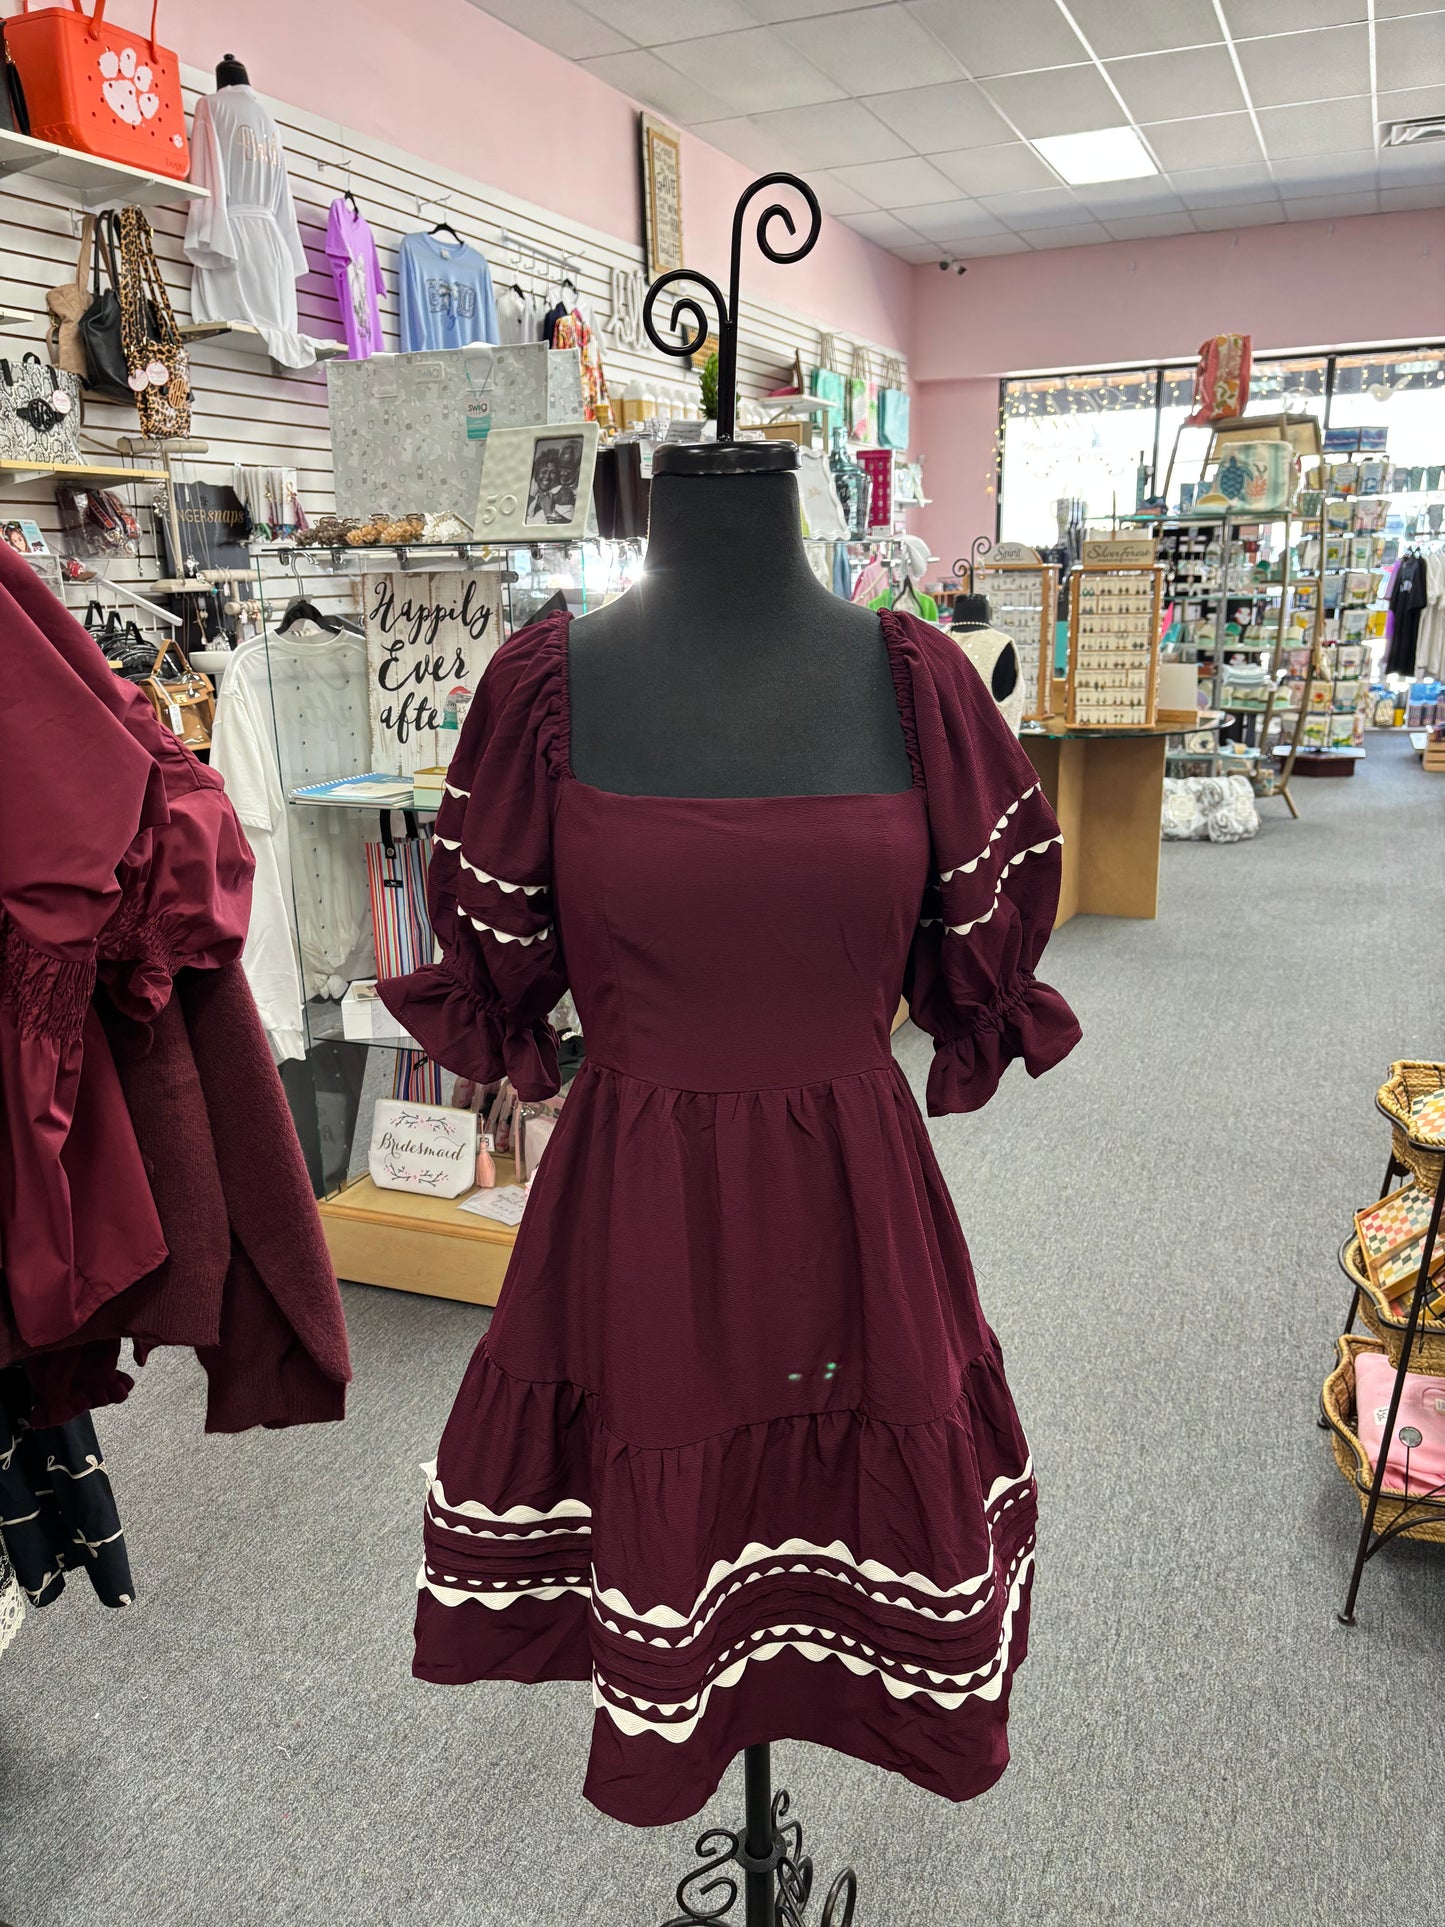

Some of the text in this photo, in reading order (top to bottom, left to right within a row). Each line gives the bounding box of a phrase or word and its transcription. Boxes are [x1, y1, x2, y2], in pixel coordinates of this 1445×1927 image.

[481, 494, 519, 525] 50
[369, 580, 493, 646] Happily
[378, 639, 470, 692] Ever
[380, 691, 441, 744] afte
[378, 1132, 467, 1163] Bridesmaid
